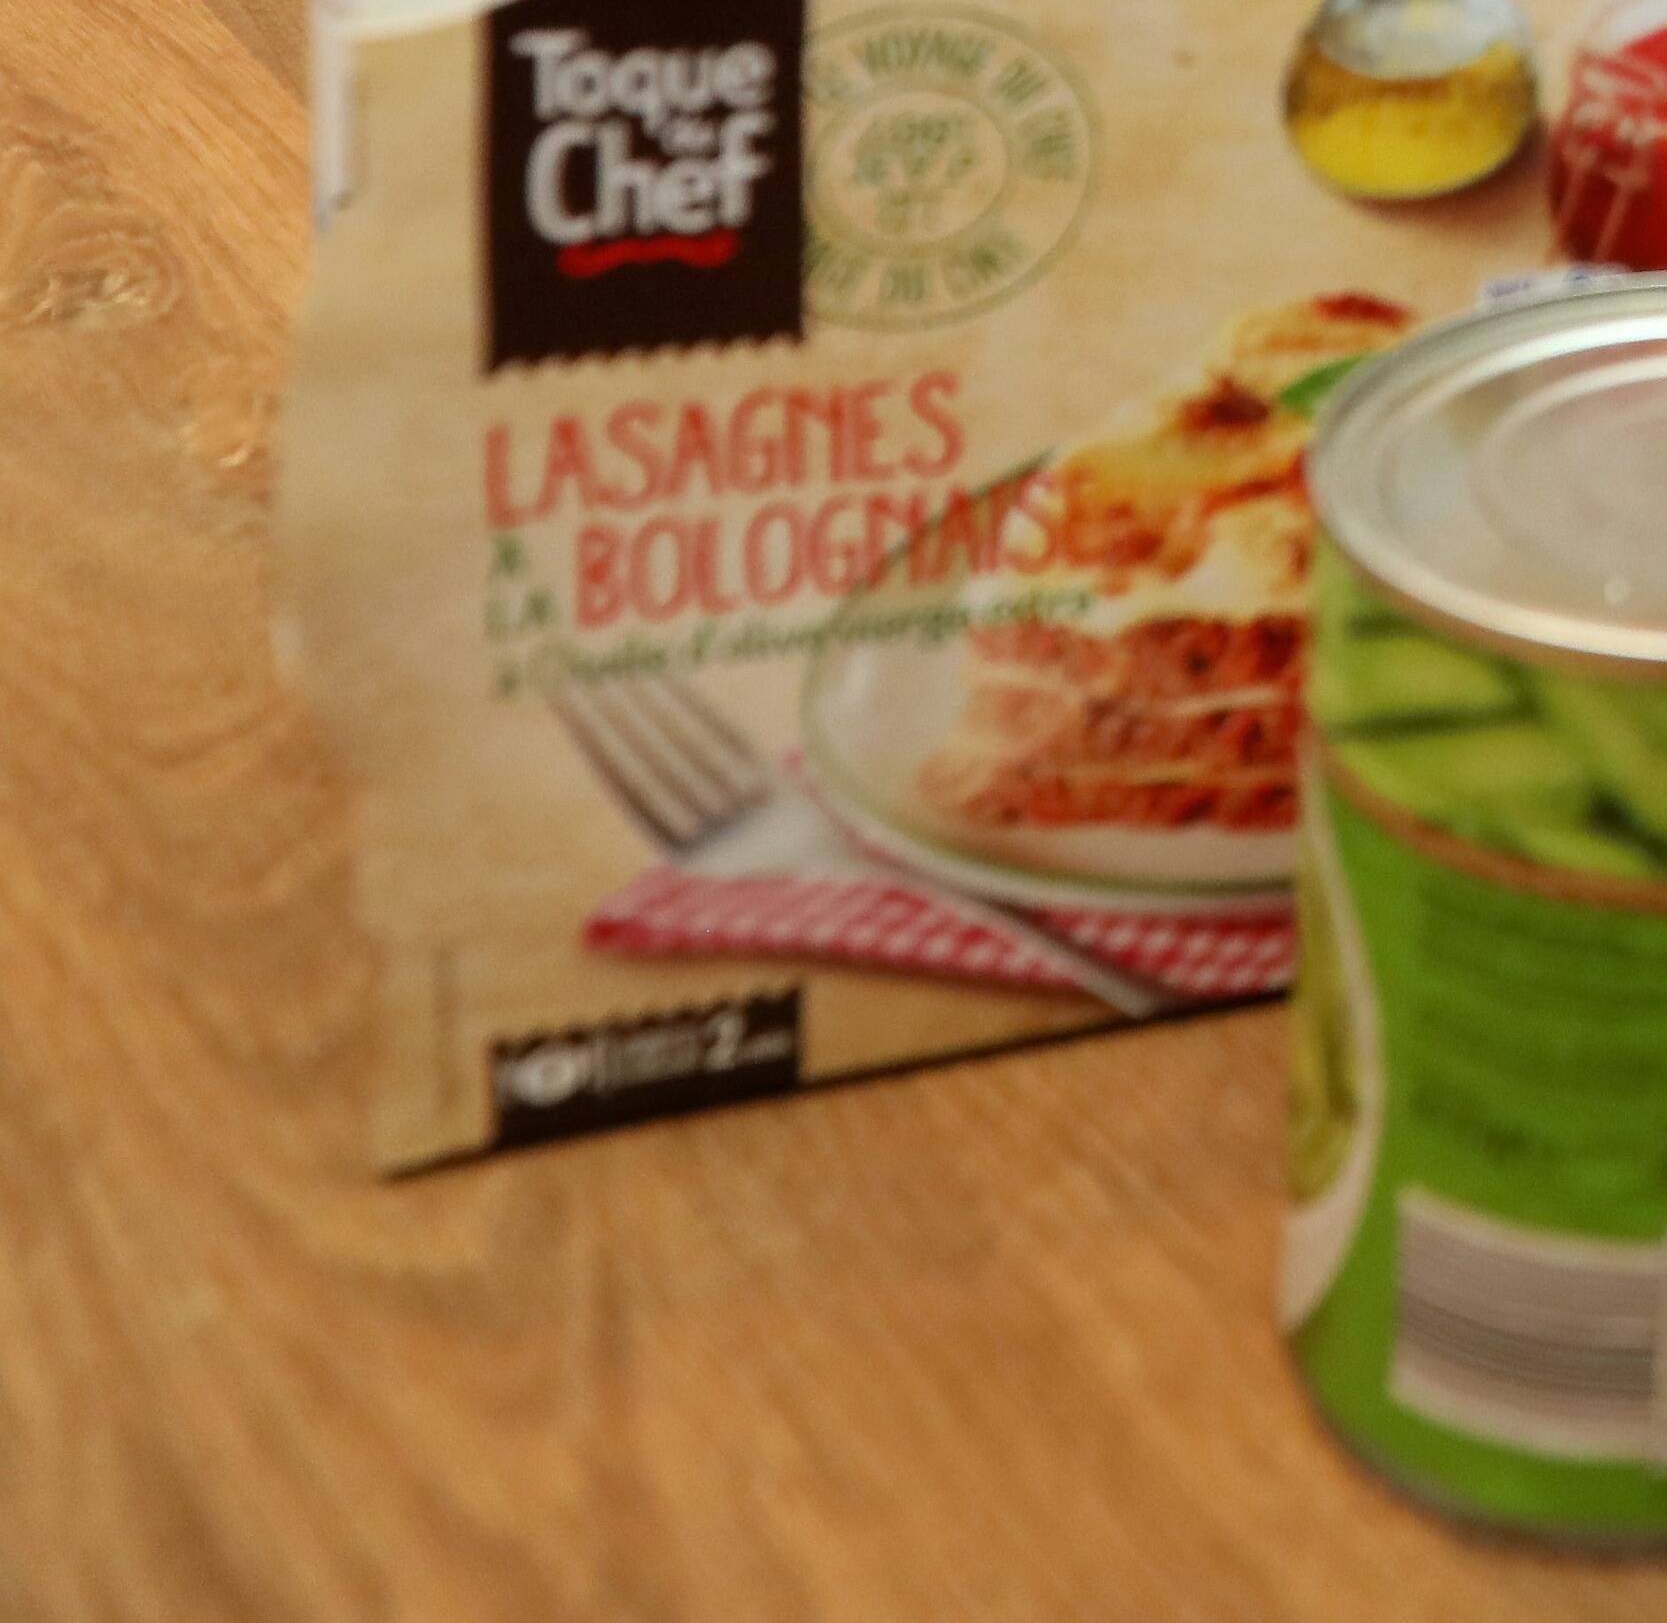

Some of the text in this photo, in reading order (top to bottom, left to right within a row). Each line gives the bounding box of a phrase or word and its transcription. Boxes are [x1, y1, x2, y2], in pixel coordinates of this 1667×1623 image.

[511, 29, 776, 134] Toque
[525, 110, 775, 244] Chef
[484, 370, 965, 532] LASAGNES
